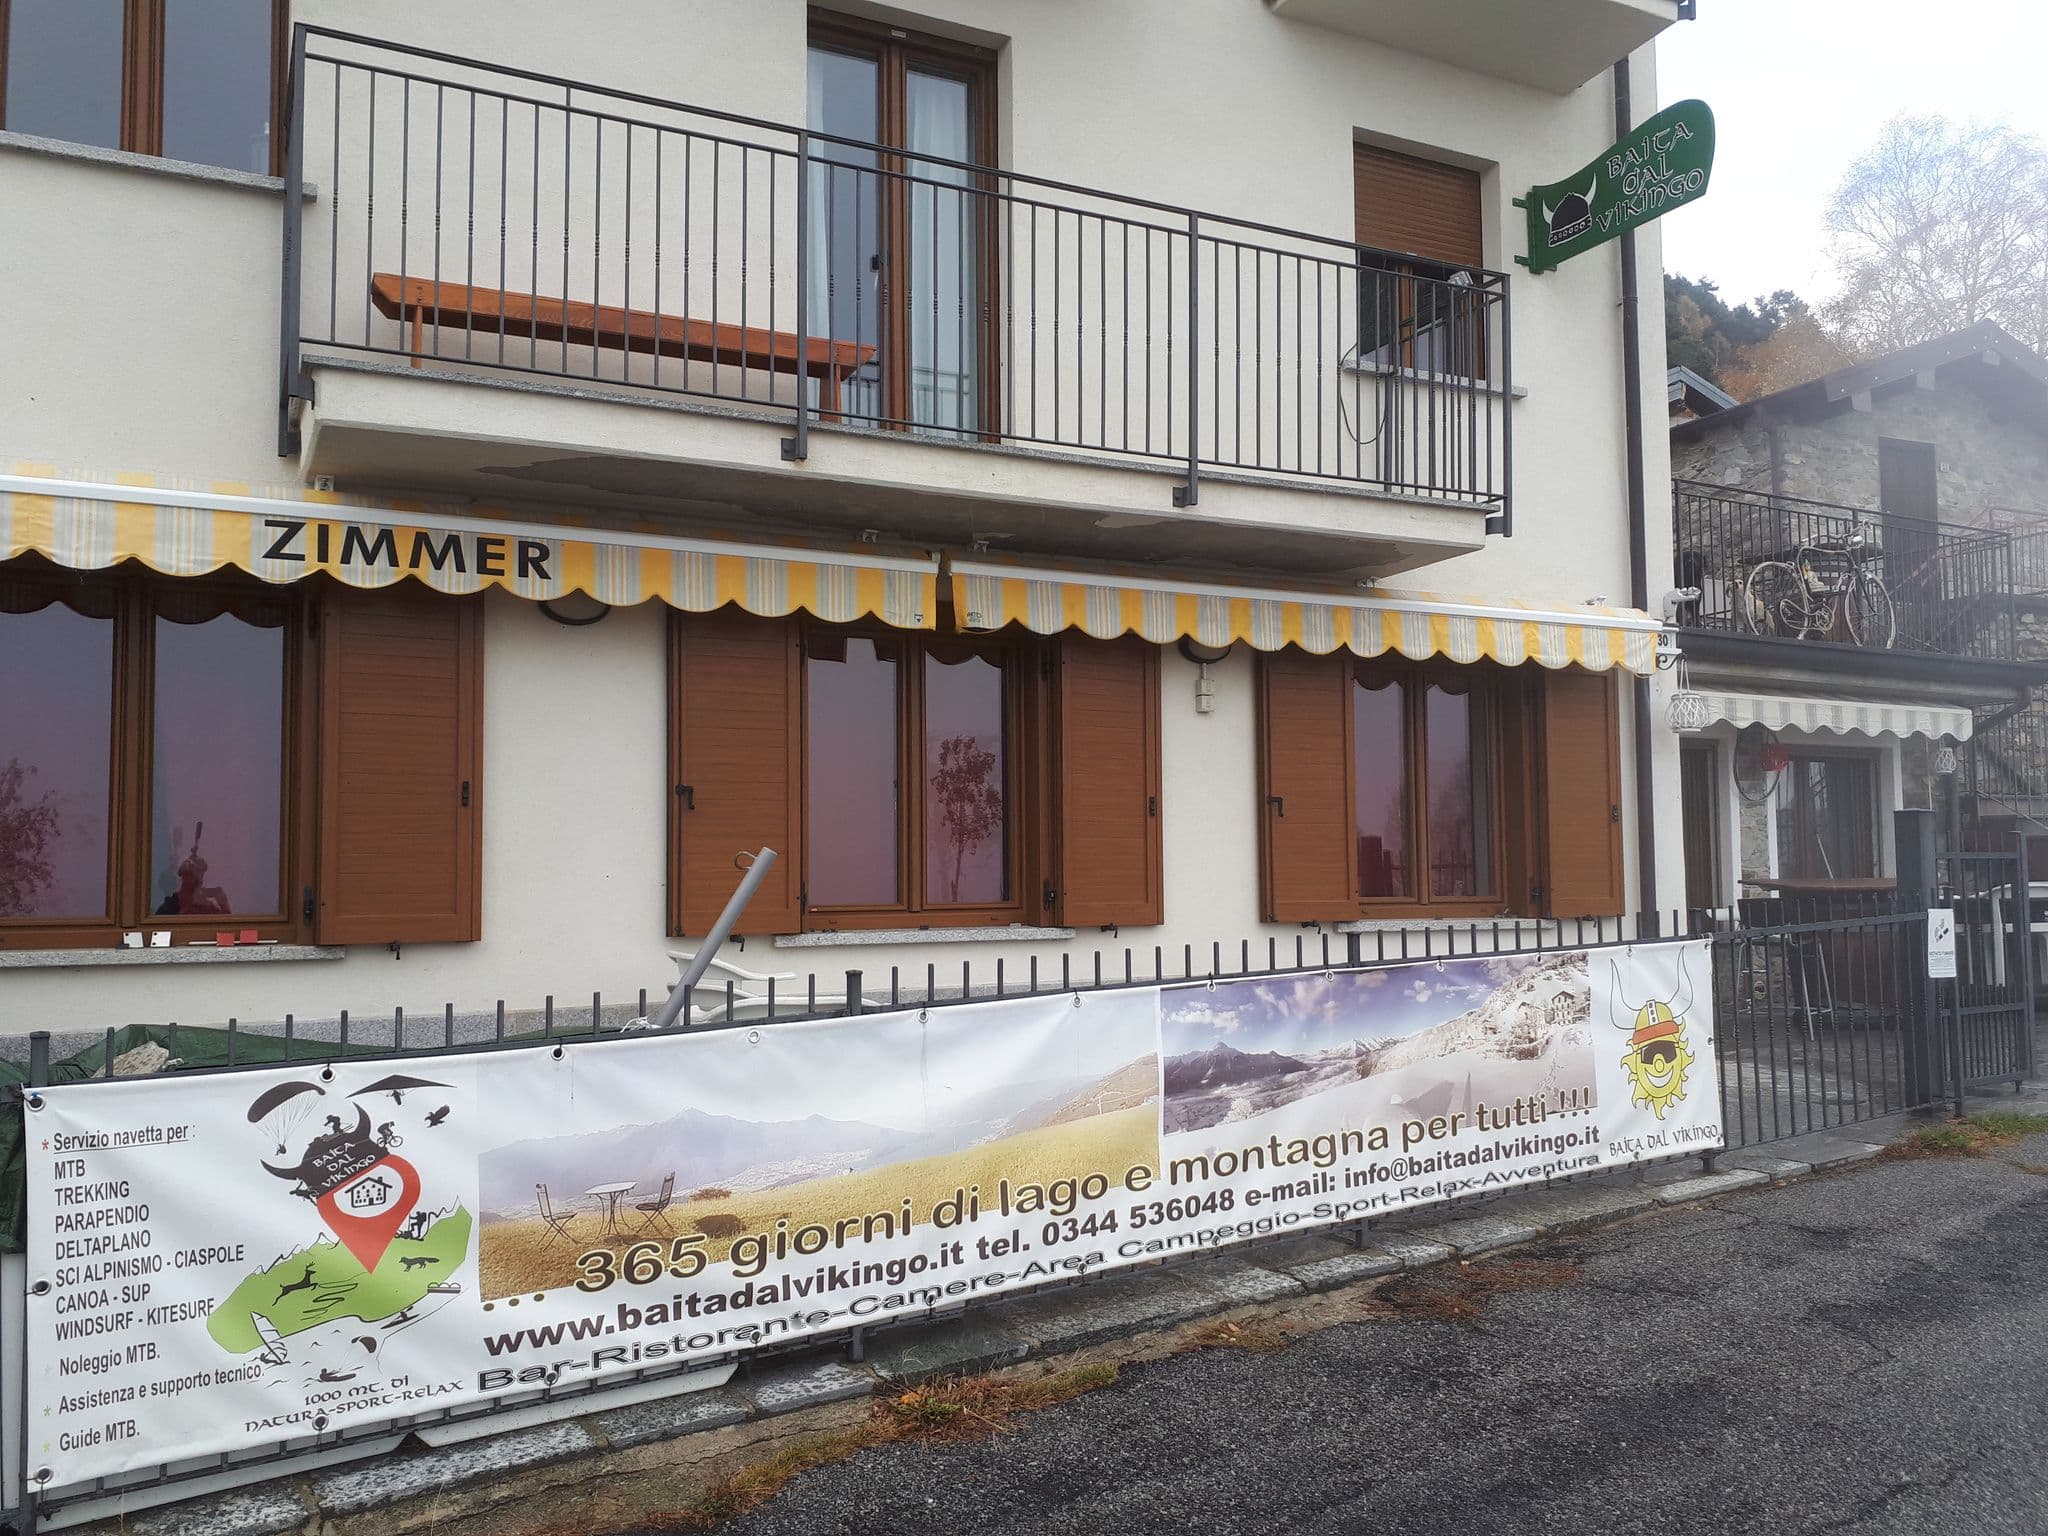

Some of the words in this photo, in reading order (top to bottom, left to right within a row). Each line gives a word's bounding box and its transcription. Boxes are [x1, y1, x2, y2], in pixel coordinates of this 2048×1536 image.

[1606, 121, 1694, 179] BAITA
[262, 519, 552, 580] ZIMMER
[1657, 633, 1669, 647] 30
[53, 1130, 110, 1150] Servizio
[113, 1126, 163, 1147] navetta
[54, 1158, 86, 1180] MTB
[54, 1180, 130, 1206] TREKKING
[576, 1234, 708, 1292] 365
[730, 1197, 912, 1278] giorni
[932, 1185, 980, 1229] di
[999, 1171, 1110, 1217] lago
[1125, 1164, 1153, 1191] e
[1169, 1125, 1389, 1185] montagna
[1402, 1112, 1466, 1153] per
[1475, 1093, 1547, 1132] tutti
[55, 1204, 150, 1233] PARAPENDIO
[55, 1229, 151, 1260] DELTAPLANO
[483, 1240, 965, 1356] www.baitadalvikingo.it
[975, 1229, 1030, 1260] tel.
[1042, 1209, 1119, 1246] 0344
[1129, 1188, 1235, 1229] 536048
[1245, 1171, 1335, 1207] e-mail:
[1345, 1125, 1600, 1188] info@baitadalvikingo.it
[55, 1269, 80, 1288] SCI
[83, 1254, 162, 1283] ALPINISMO
[174, 1244, 245, 1268] CIASPOLE
[55, 1289, 109, 1314] CANOA
[122, 1283, 151, 1304] SUP
[55, 1311, 133, 1341] WINDSURF
[147, 1298, 215, 1326] KITESURF
[59, 1351, 122, 1376] Noleggio
[126, 1342, 160, 1364] MTB.
[58, 1385, 135, 1414] Assistenza
[139, 1385, 147, 1398] e
[150, 1370, 211, 1398] supporto
[305, 1390, 342, 1406] 1000
[59, 1428, 101, 1451] Guide
[105, 1419, 140, 1442] MTB.
